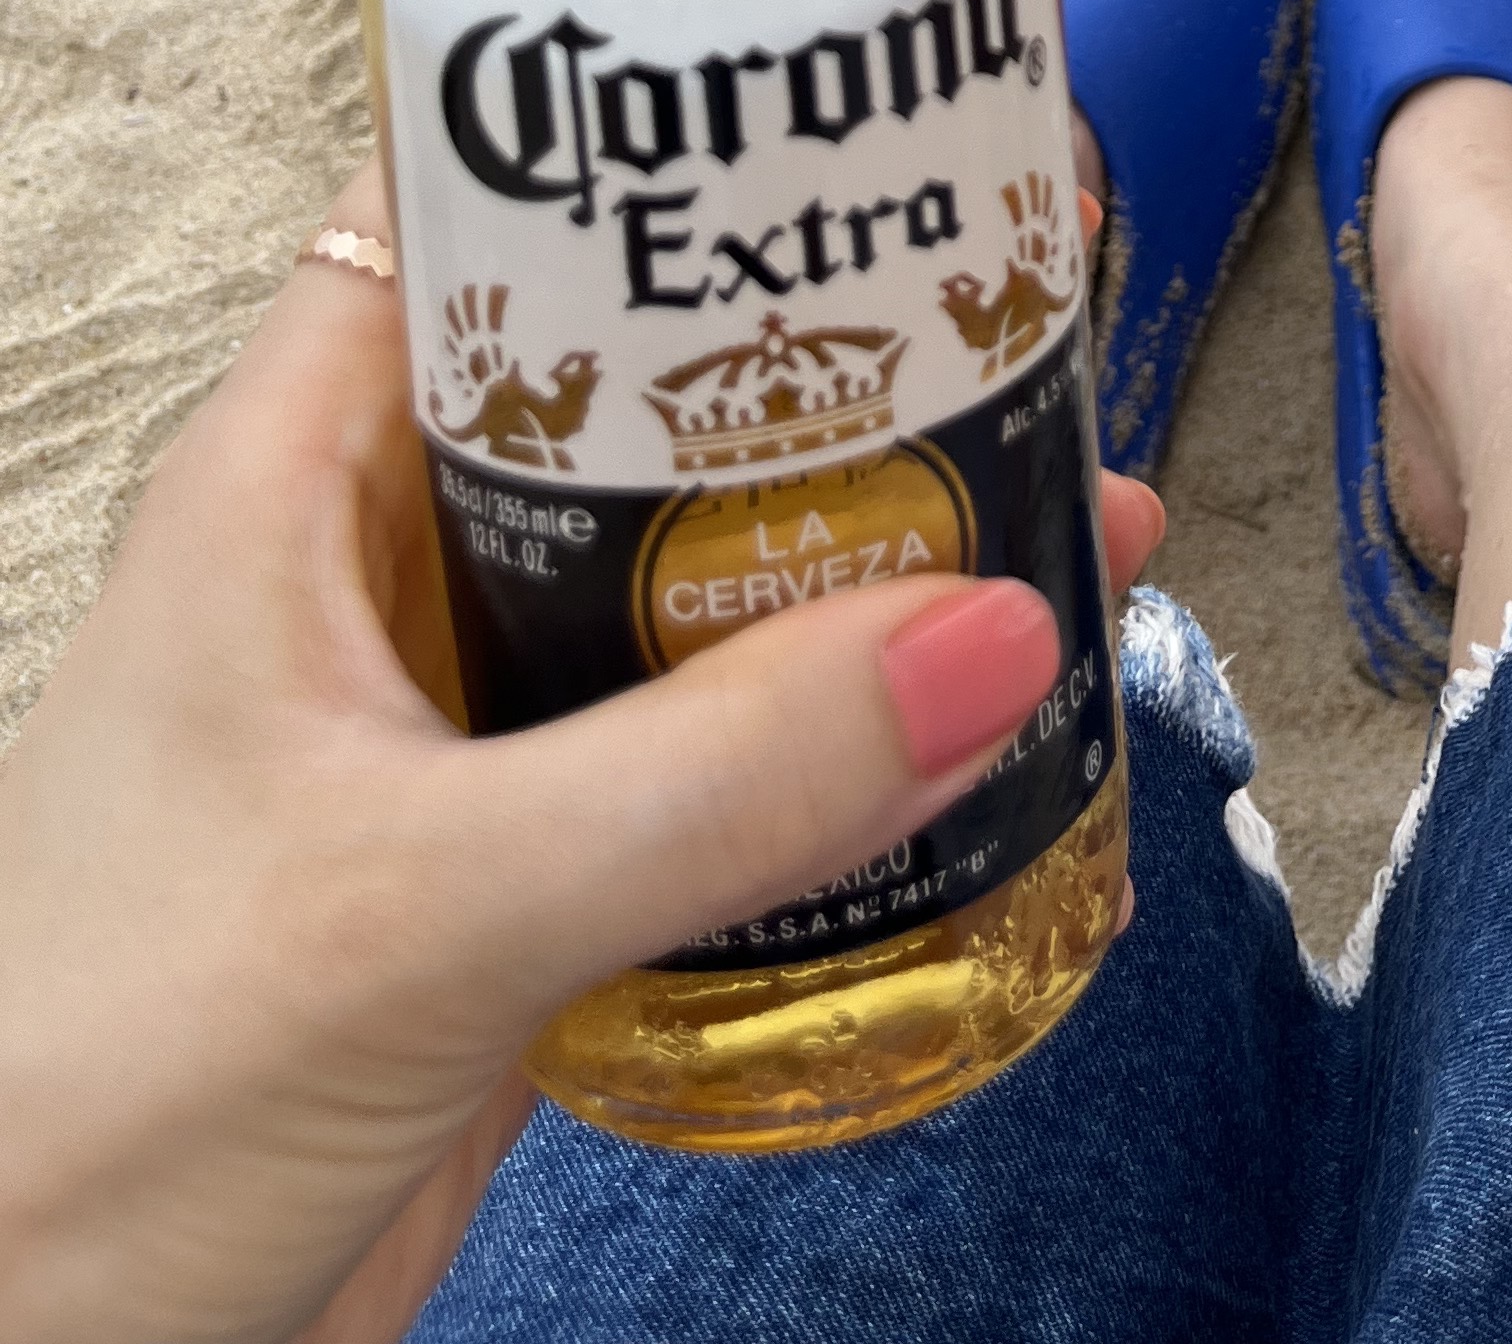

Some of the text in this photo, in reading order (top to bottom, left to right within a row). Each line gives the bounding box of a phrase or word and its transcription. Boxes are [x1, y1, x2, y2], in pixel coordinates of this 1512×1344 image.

[612, 177, 964, 311] Extra
[756, 509, 835, 562] LA
[664, 528, 933, 622] CERVEZA
[890, 869, 947, 912] 7417
